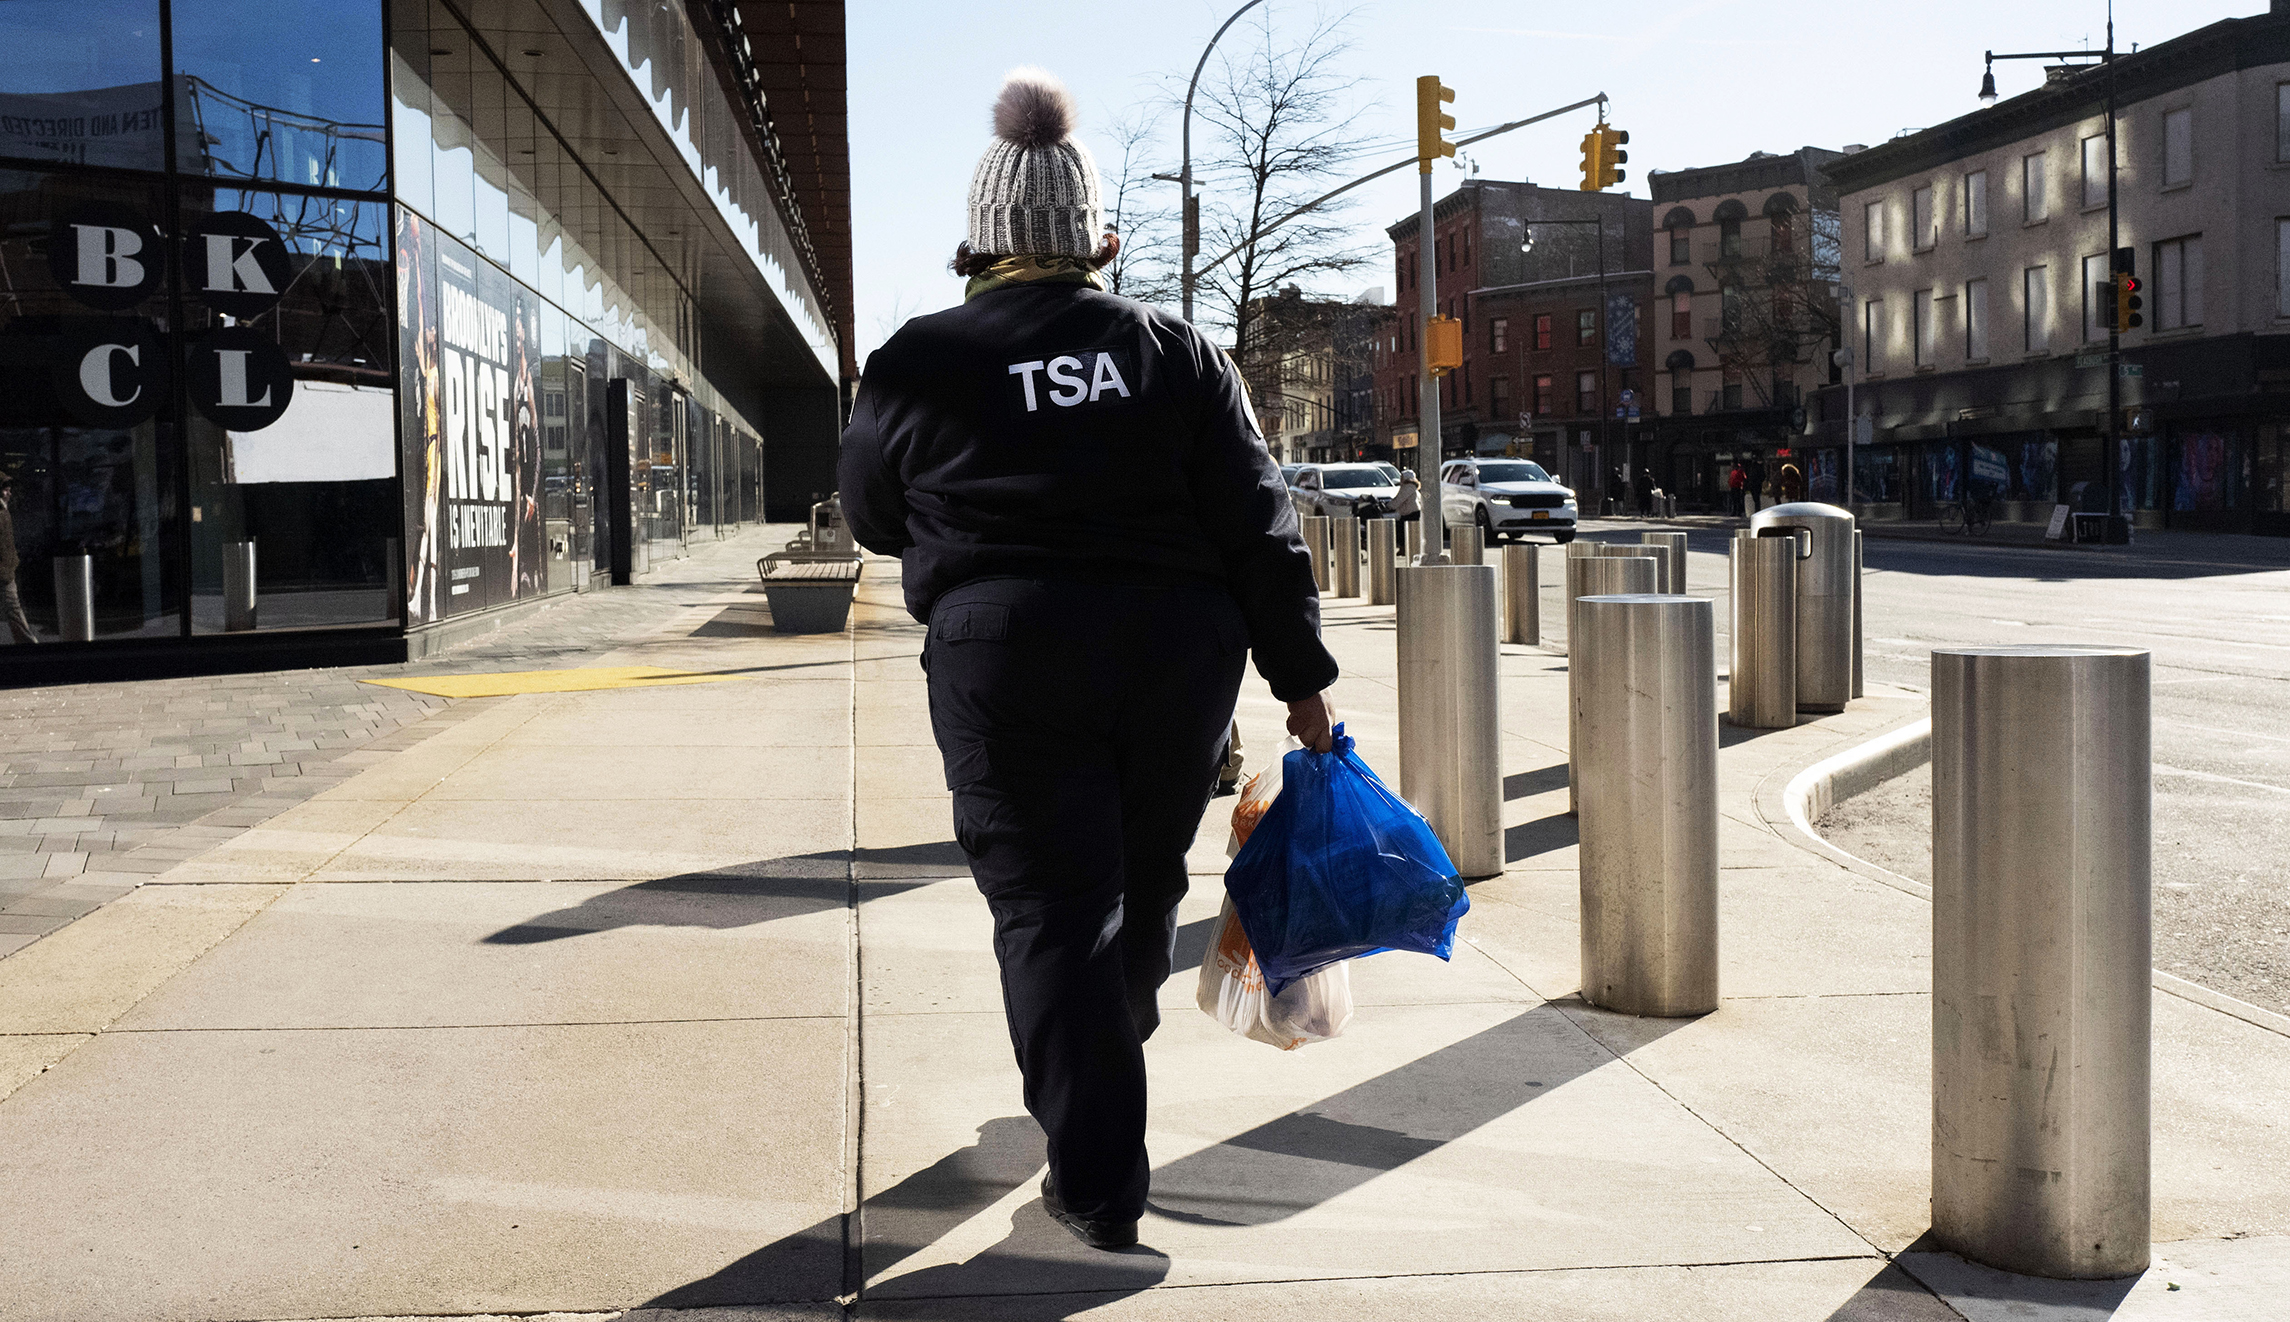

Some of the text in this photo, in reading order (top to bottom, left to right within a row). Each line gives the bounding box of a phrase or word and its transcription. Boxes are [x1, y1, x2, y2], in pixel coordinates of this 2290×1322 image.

[70, 224, 278, 294] B K
[442, 281, 508, 366] BROOKLYN'S
[79, 344, 271, 407] C L
[1008, 352, 1131, 412] TSA
[444, 347, 512, 502] RISE
[449, 504, 507, 549] IS INEVITABLE
